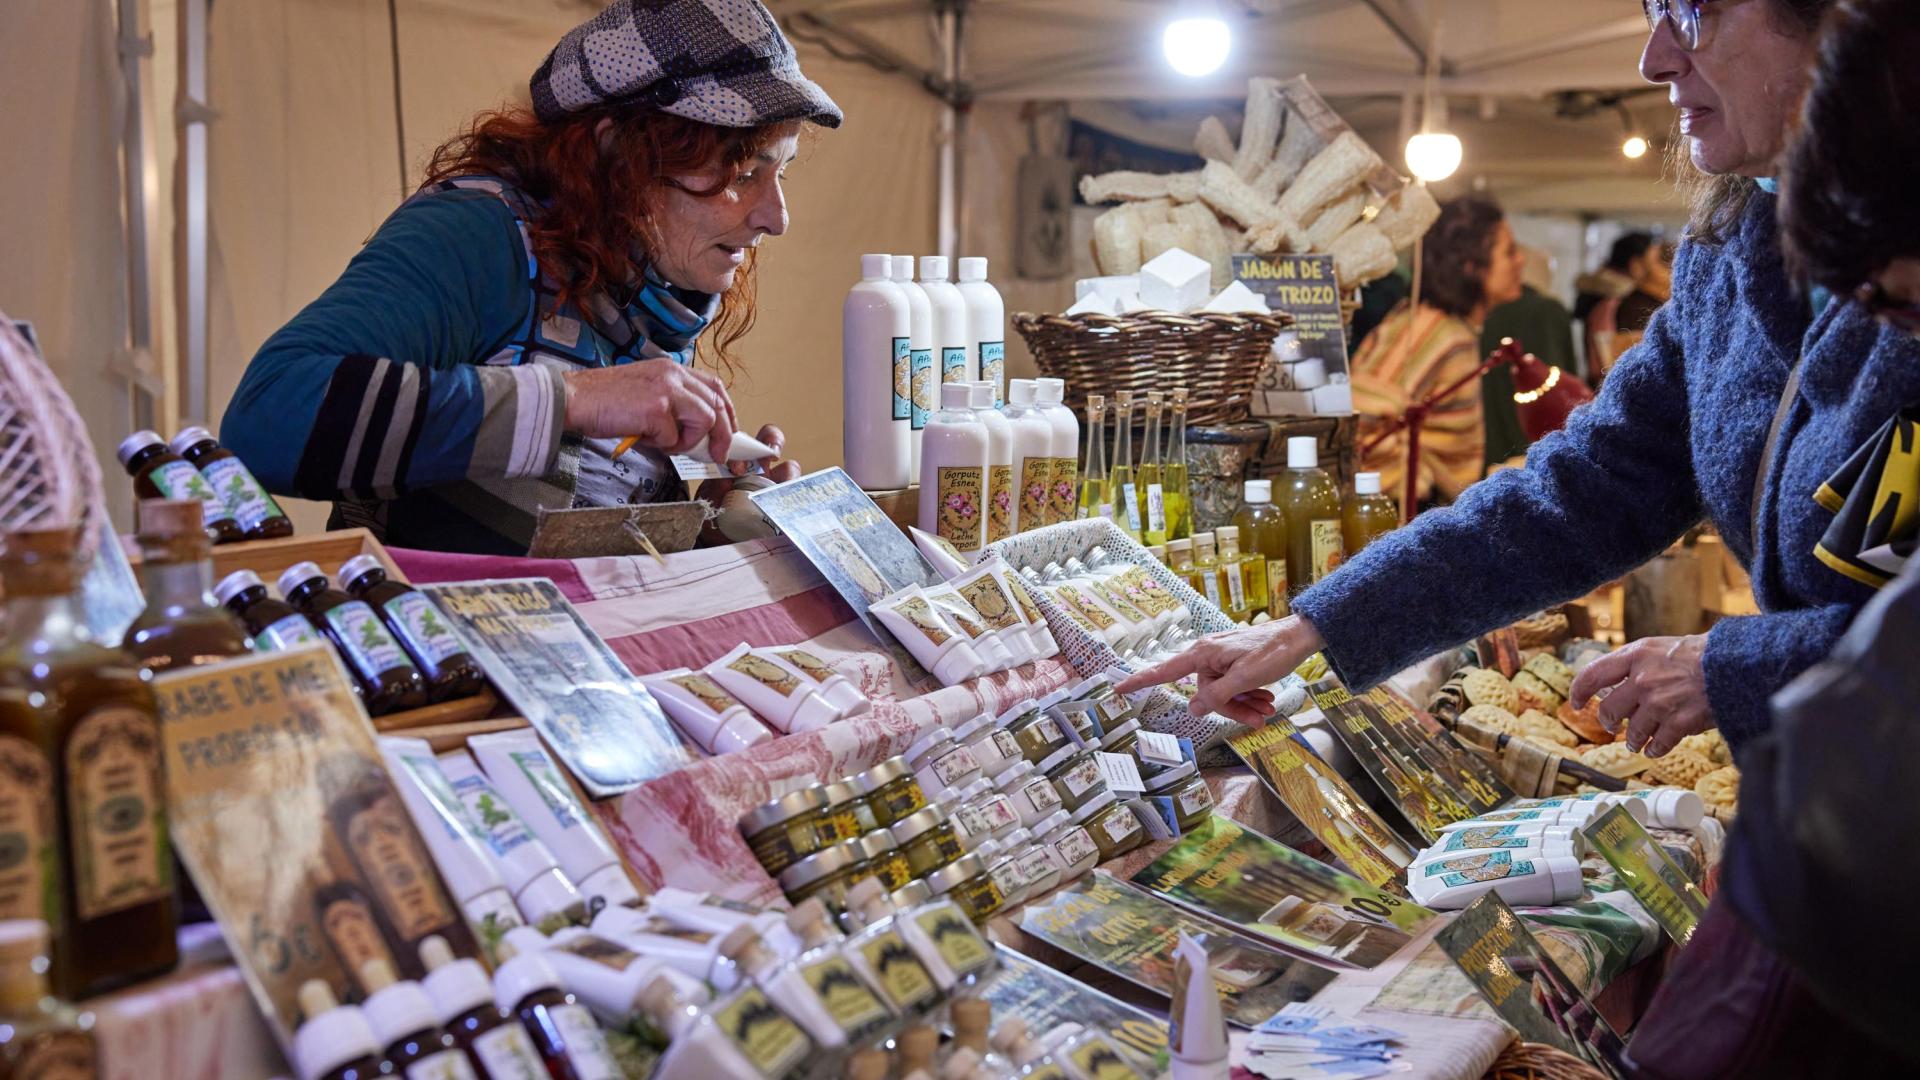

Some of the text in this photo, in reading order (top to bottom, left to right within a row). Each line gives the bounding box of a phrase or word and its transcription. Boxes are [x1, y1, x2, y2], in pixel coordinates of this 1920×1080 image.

[1301, 260, 1322, 279] DE
[1278, 285, 1334, 304] TROZO
[944, 470, 980, 480] Gorputz
[950, 479, 976, 488] Esnea
[951, 532, 974, 541] Leche
[950, 539, 978, 550] orporal
[232, 671, 273, 707] DE
[1090, 911, 1148, 945] CUTIS
